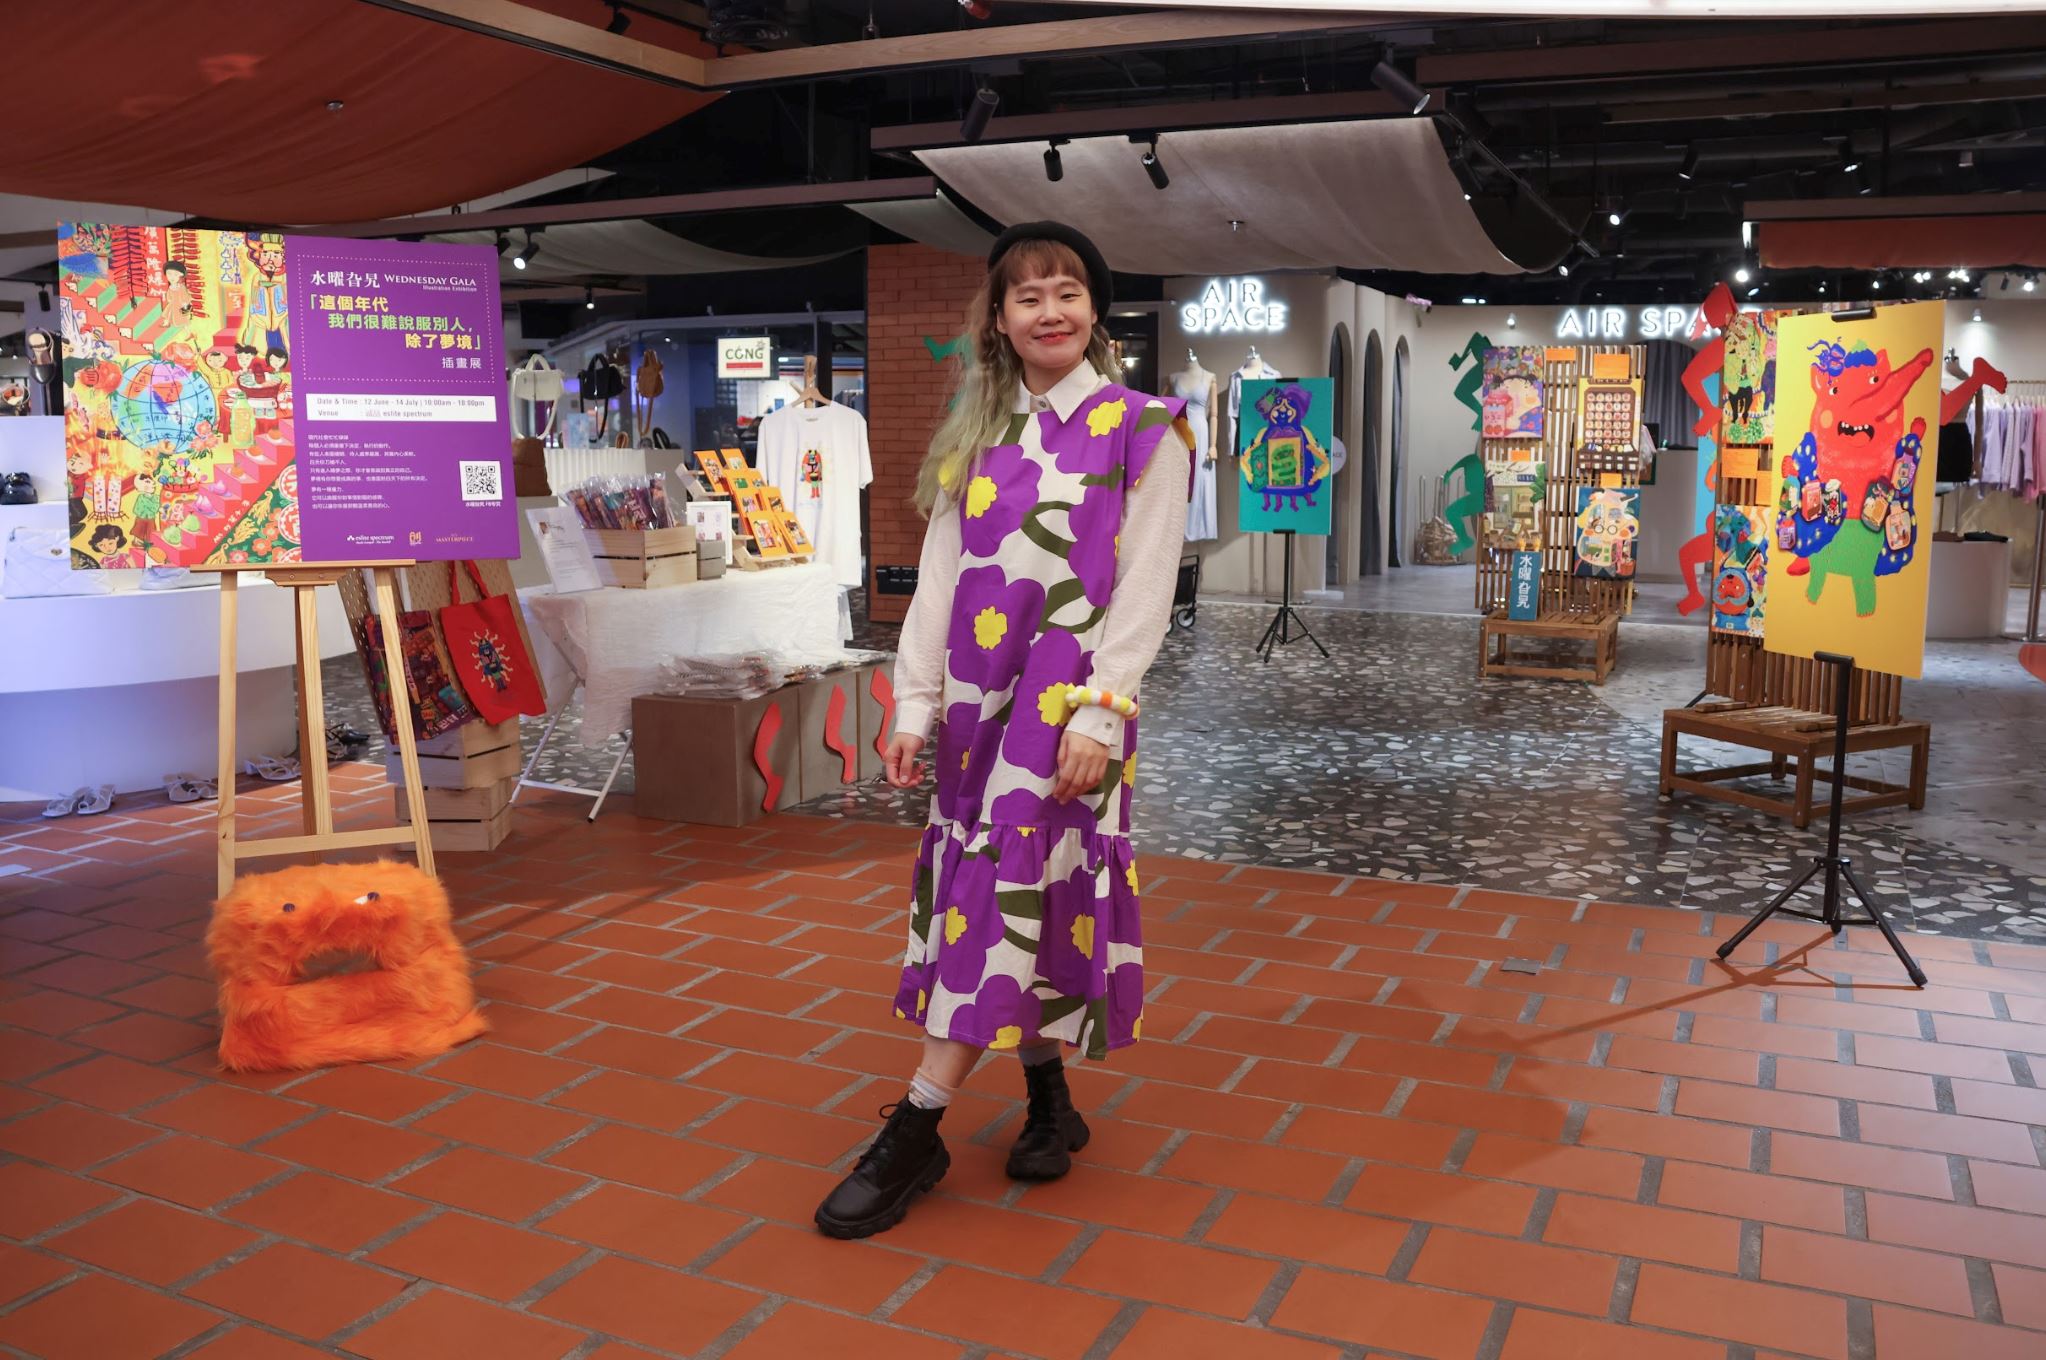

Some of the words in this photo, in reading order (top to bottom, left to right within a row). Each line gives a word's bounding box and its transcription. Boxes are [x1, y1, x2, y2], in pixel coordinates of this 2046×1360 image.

[449, 276, 477, 287] GALA
[1202, 281, 1261, 304] AIR
[309, 293, 390, 312] 「這個年代
[1182, 305, 1286, 330] SPACE
[1559, 310, 1625, 335] AIR
[405, 333, 481, 350] 除了夢境」
[441, 357, 482, 369] 插畫展
[317, 397, 333, 405] Date
[405, 399, 418, 407] July
[403, 411, 433, 419] spectrum
